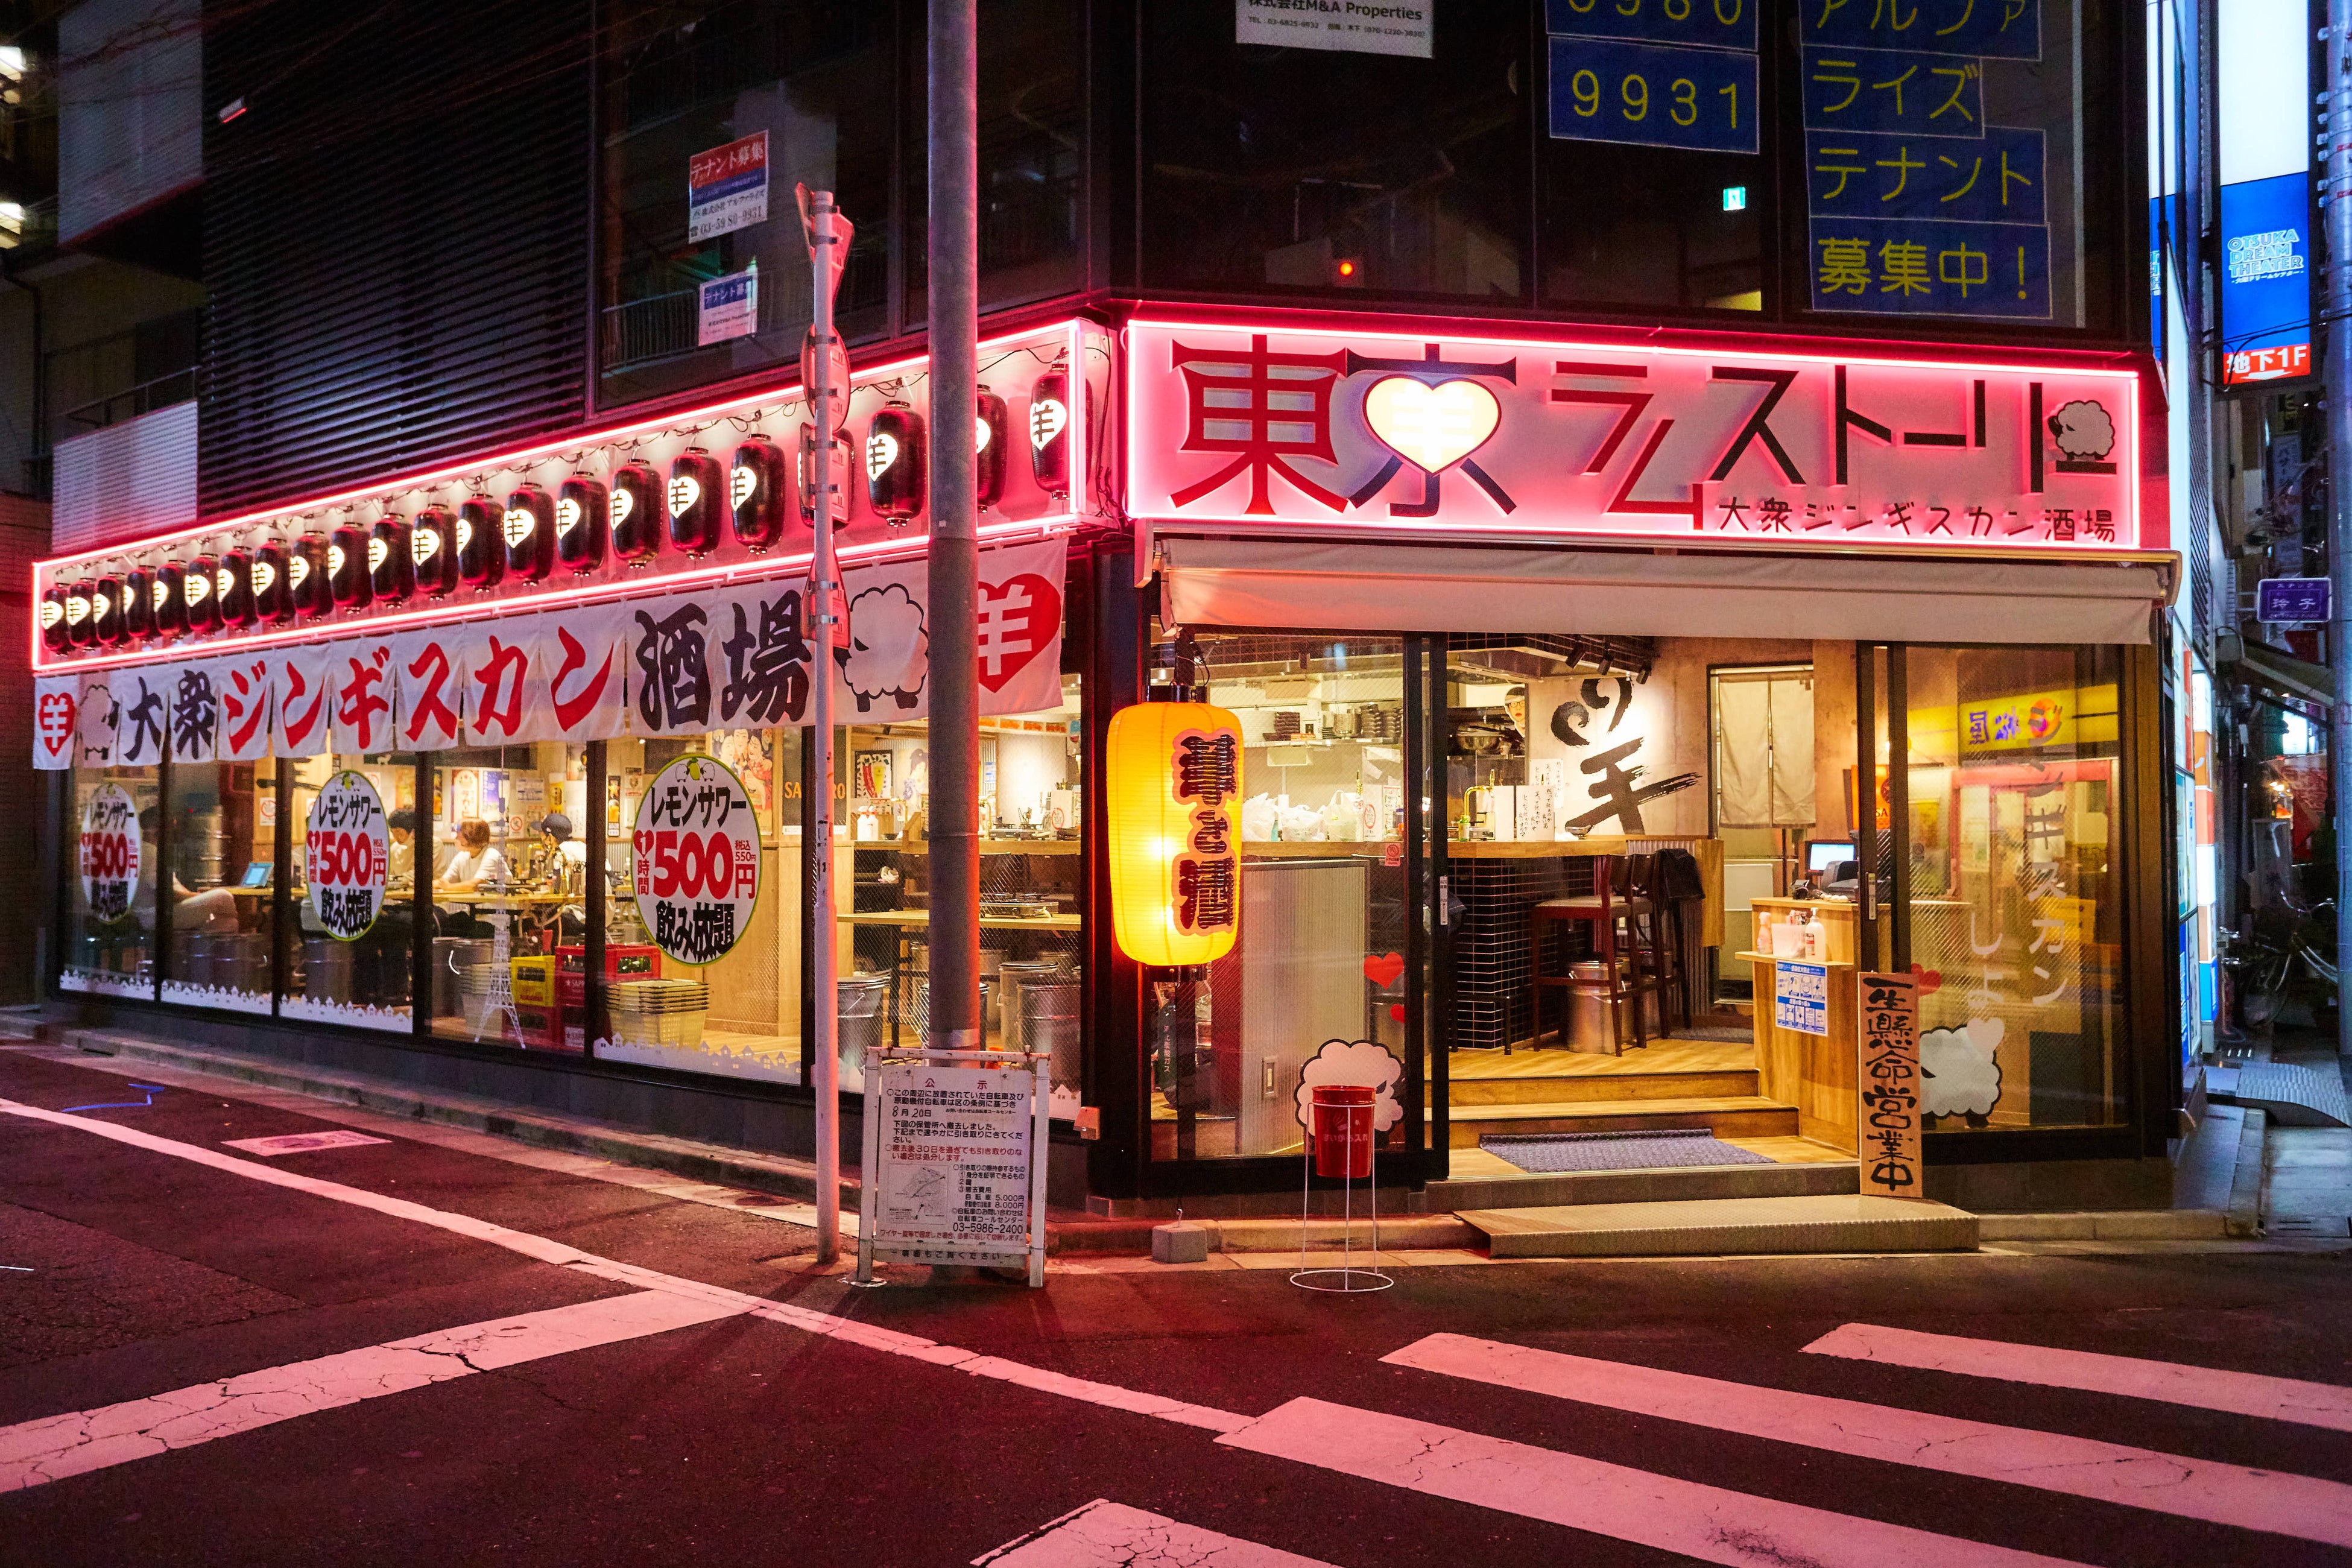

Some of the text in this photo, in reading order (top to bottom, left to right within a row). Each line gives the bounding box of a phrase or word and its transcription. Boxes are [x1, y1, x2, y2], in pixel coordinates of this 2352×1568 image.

[1346, 2, 1423, 21] Properties
[1572, 69, 1737, 129] 9931
[1812, 60, 1979, 122] ライズ
[1815, 147, 2031, 206] テナント
[2228, 229, 2300, 251] OTSUKA
[2230, 242, 2292, 264] DREAM
[2229, 256, 2304, 277] THEATER
[2227, 346, 2307, 374] 地下1F
[1718, 498, 2114, 543] 大衆ジンギスカン酒場
[978, 584, 1033, 676] 羊
[123, 588, 812, 762] 大衆ジンギスカン酒場
[43, 698, 67, 748] 羊
[90, 800, 134, 830] レモンサワー
[318, 794, 381, 829] レモンサワー
[651, 785, 747, 829] レモンサワー
[735, 839, 751, 850] 税込
[735, 851, 756, 861] 550円
[2026, 704, 2067, 1006] ジンギスカン
[321, 887, 373, 936] 飲み放題
[656, 900, 735, 963] 飲み放題
[1862, 976, 1918, 1192] 一生懸命営業中
[952, 1222, 1023, 1234] 03-5986-2400
